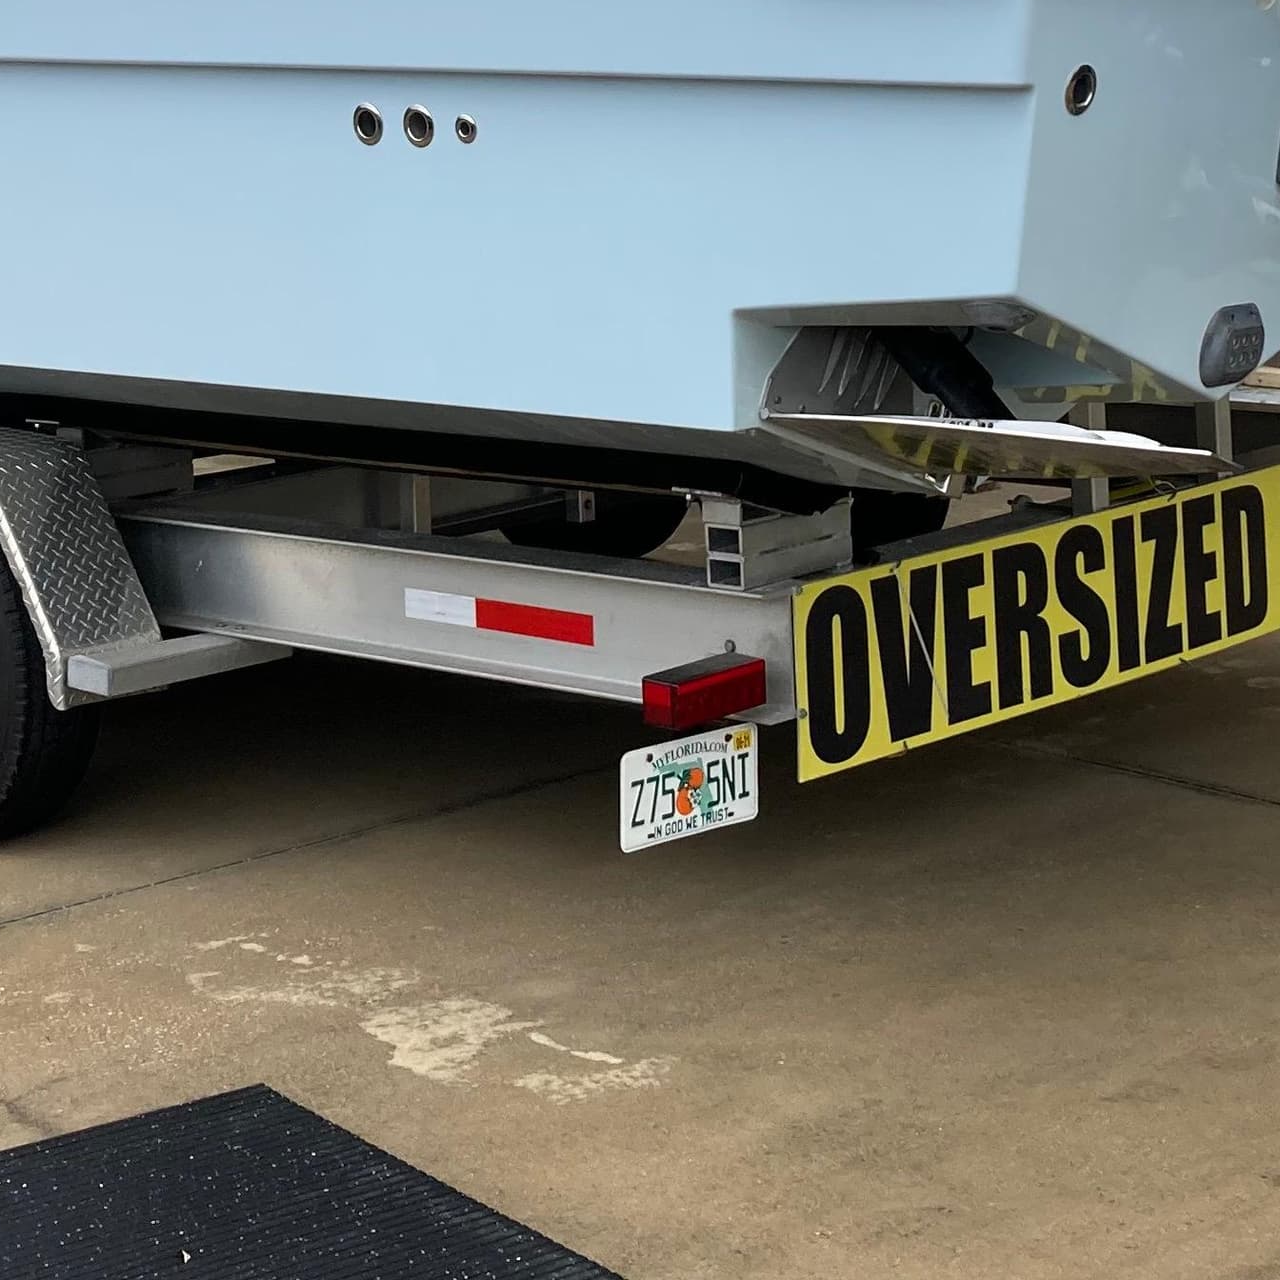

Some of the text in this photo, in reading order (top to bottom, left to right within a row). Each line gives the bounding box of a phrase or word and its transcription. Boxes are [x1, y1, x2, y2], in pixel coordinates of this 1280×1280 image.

[806, 483, 1268, 764] OVERSIZED
[652, 741, 729, 770] MYFLORIDA.COM
[665, 819, 684, 837] GOD
[686, 814, 698, 829] WE
[700, 807, 729, 827] TRUST
